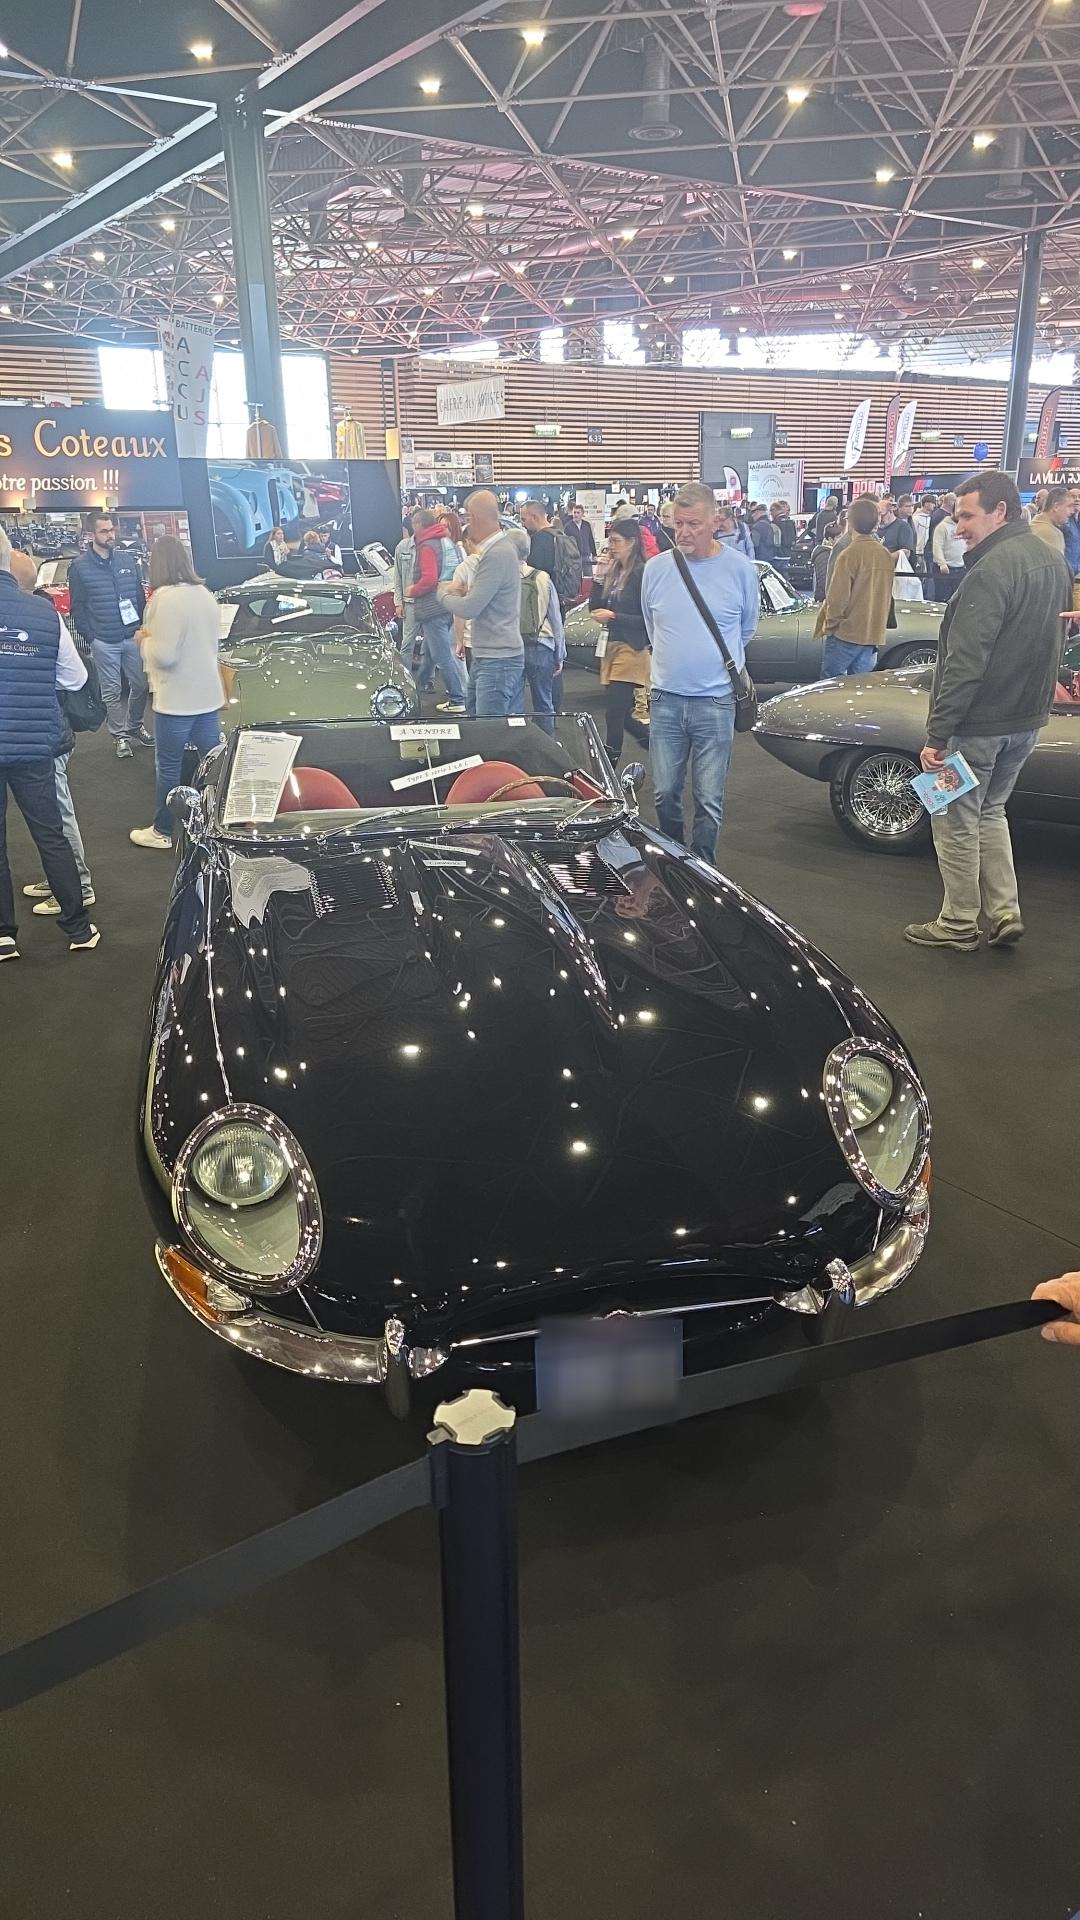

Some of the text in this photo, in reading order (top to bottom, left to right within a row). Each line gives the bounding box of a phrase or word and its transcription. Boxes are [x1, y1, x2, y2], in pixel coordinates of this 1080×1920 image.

[175, 319, 214, 337] BATTERIES
[176, 337, 191, 421] ACCU
[34, 419, 167, 458] Coteaux
[588, 434, 602, 443] 6.33
[0, 469, 119, 498] tre passion !!!
[1029, 472, 1042, 485] LA
[1042, 471, 1066, 485] VILLA
[411, 728, 453, 736] VENDRE
